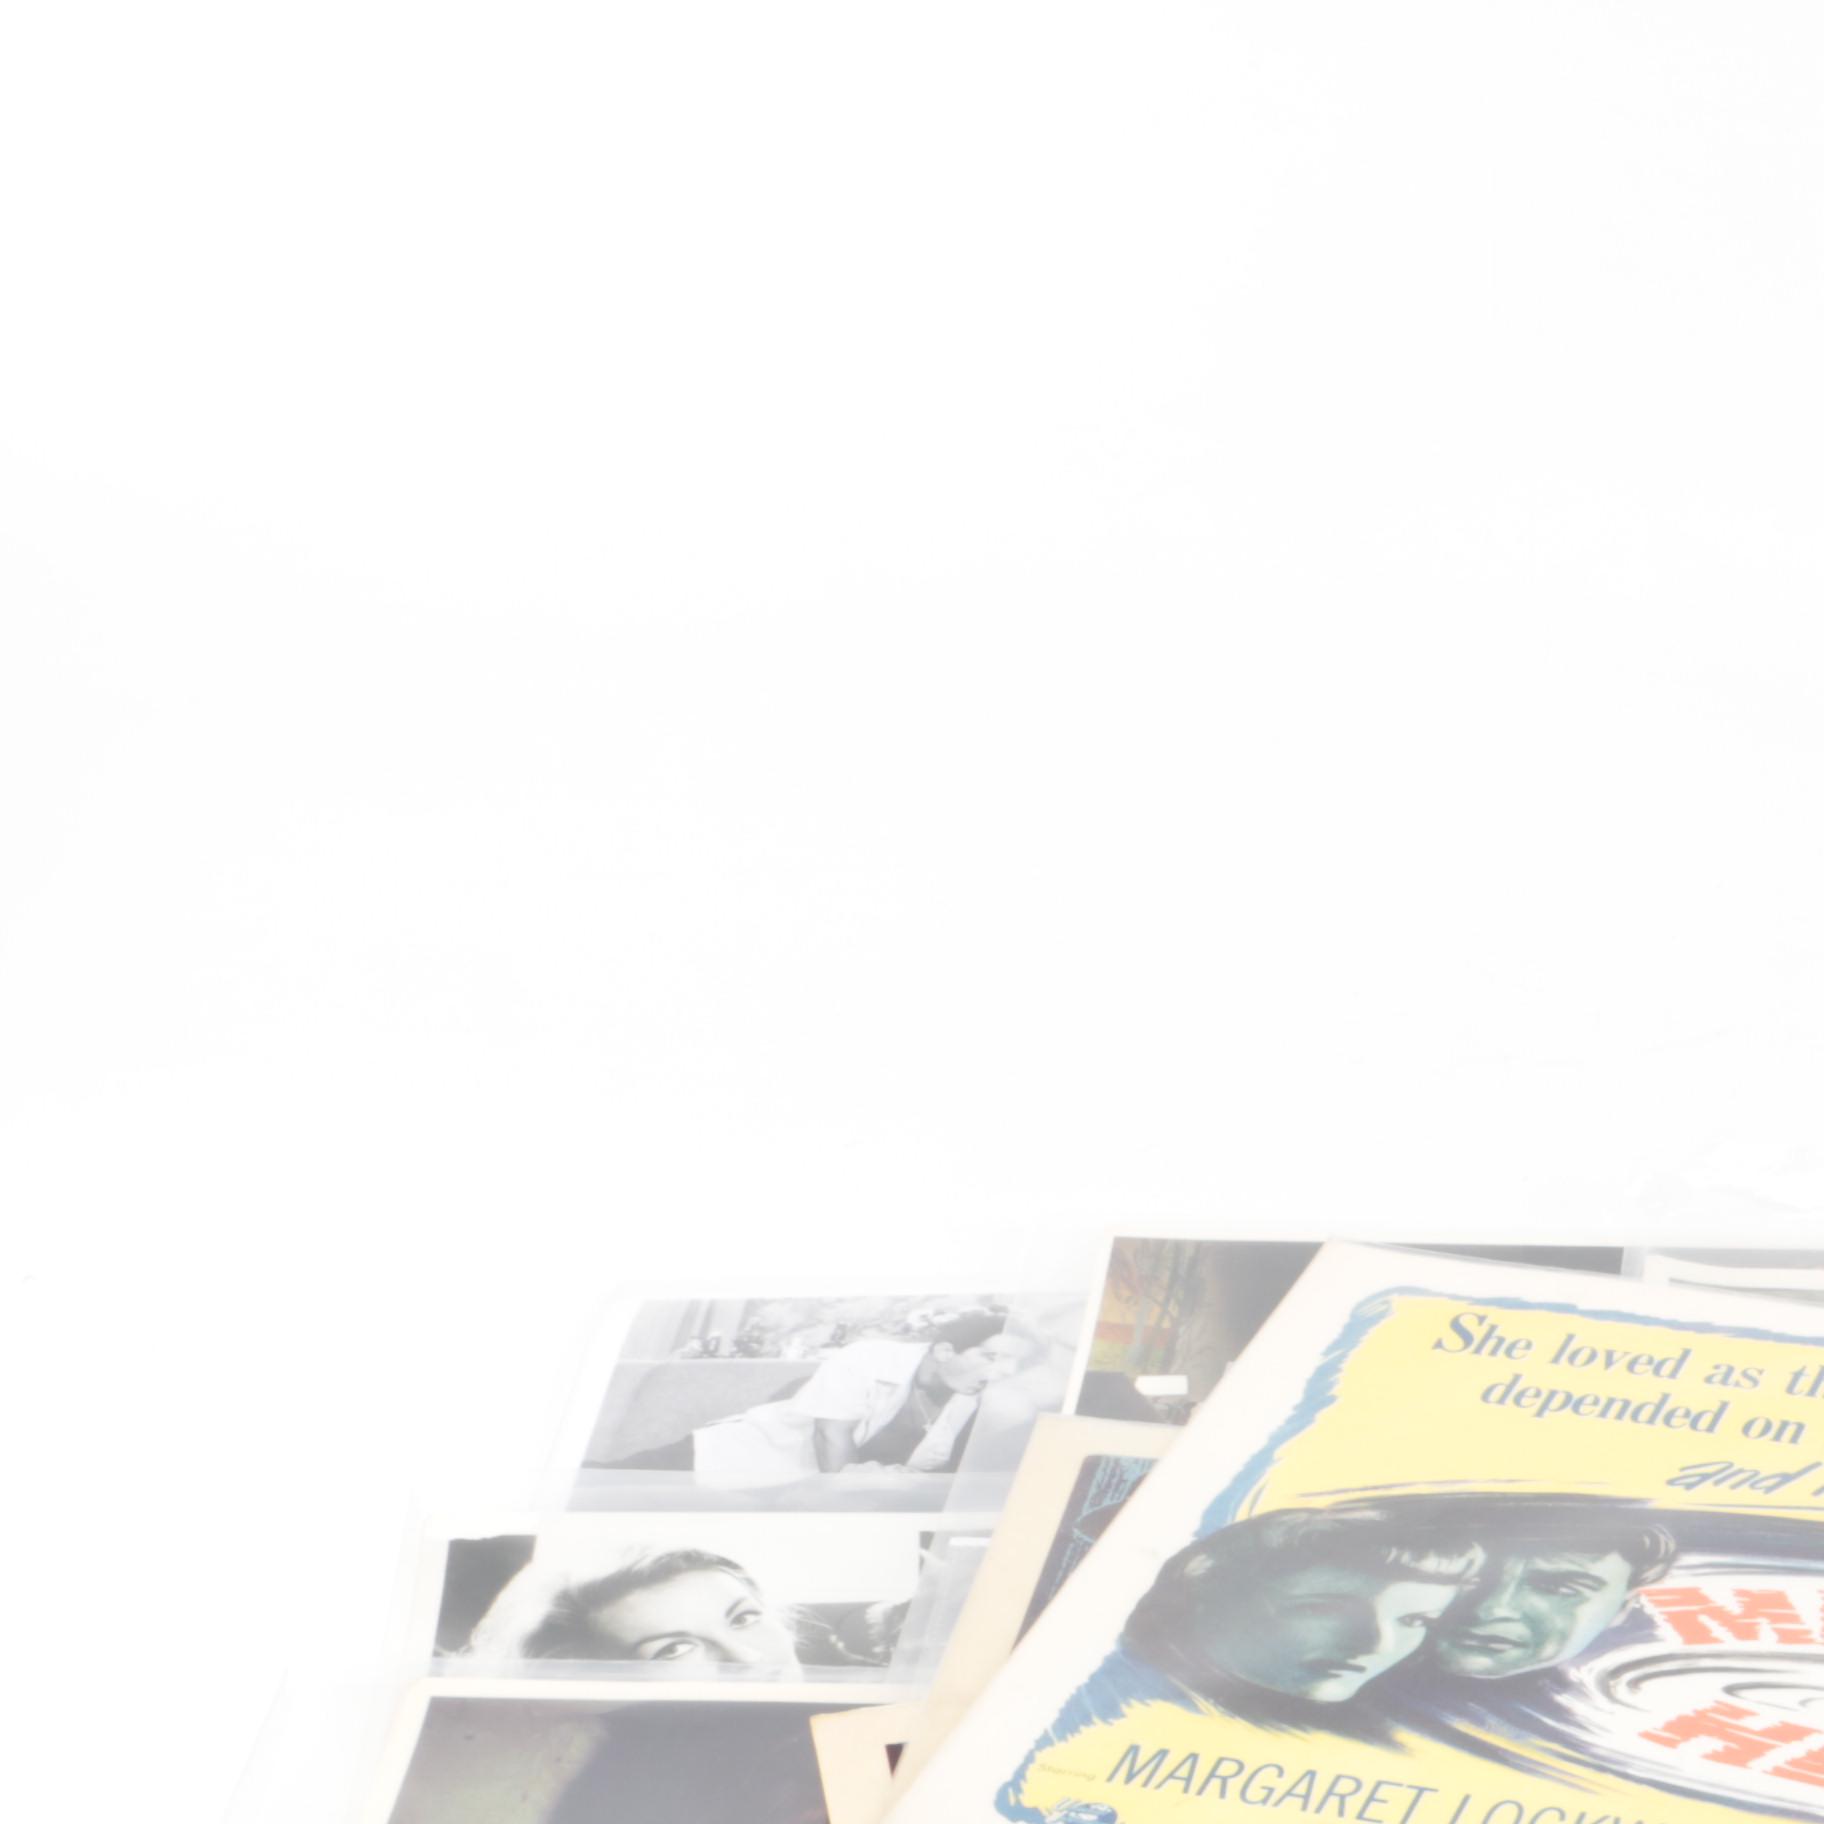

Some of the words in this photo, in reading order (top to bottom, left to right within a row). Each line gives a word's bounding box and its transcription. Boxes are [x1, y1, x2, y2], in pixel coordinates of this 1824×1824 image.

[1433, 1310, 1533, 1361] She
[1550, 1335, 1691, 1380] loved
[1704, 1362, 1762, 1390] as
[1481, 1375, 1723, 1436] depended
[1741, 1414, 1805, 1446] on
[1664, 1459, 1800, 1496] and
